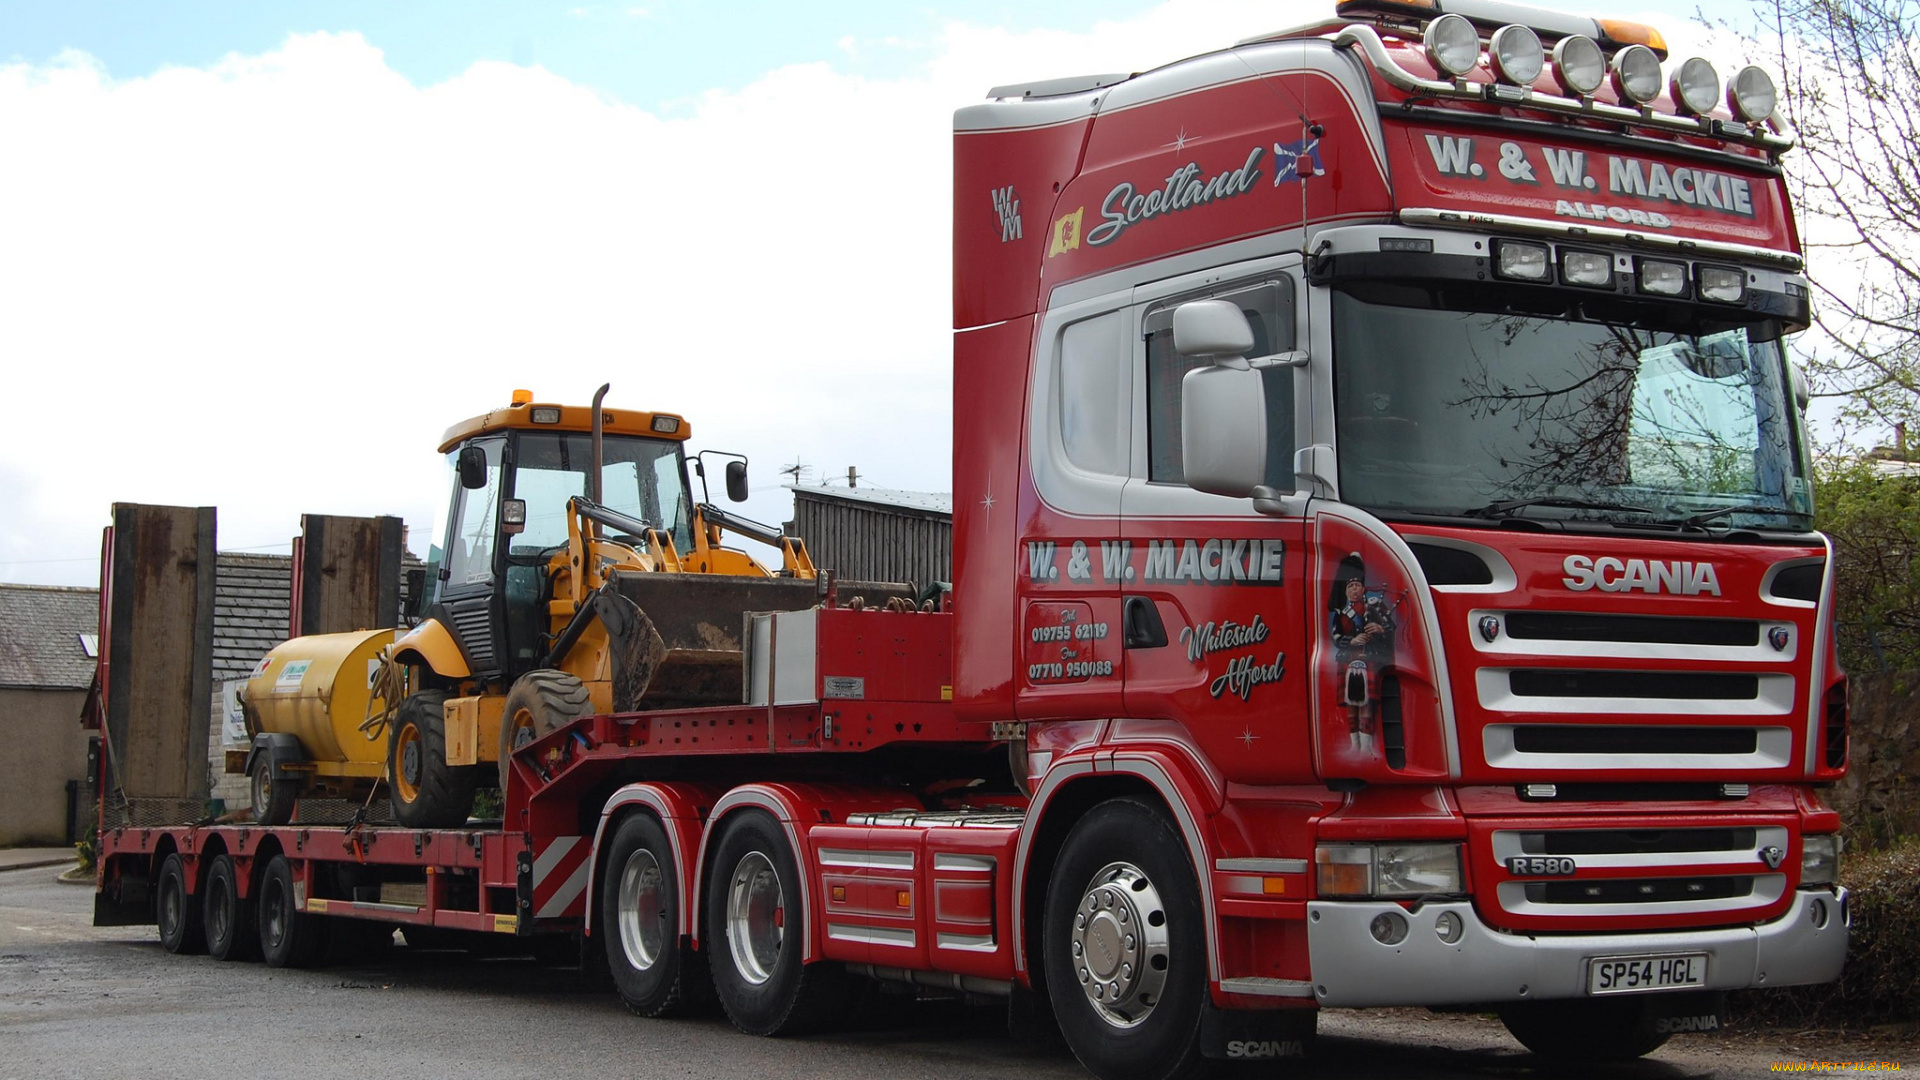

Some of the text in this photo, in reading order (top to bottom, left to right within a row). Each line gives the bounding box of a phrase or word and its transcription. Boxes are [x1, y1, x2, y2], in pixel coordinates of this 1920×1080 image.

[1425, 134, 1753, 216] W. & W. MACKIE
[1086, 146, 1266, 248] Scotland
[1554, 200, 1672, 229] ALFORD
[1028, 538, 1284, 584] W. & W. MACKIE
[1562, 555, 1722, 597] SCANIA
[1032, 622, 1108, 642] 019755 62119
[1179, 614, 1269, 662] Whiteside
[1029, 660, 1113, 679] 07710 950088
[1210, 652, 1285, 701] Alford
[1512, 857, 1574, 876] R 580
[1599, 957, 1698, 988] SP54 HGL
[1656, 1014, 1718, 1033] SCANIA
[1226, 1039, 1304, 1057] SCANIA
